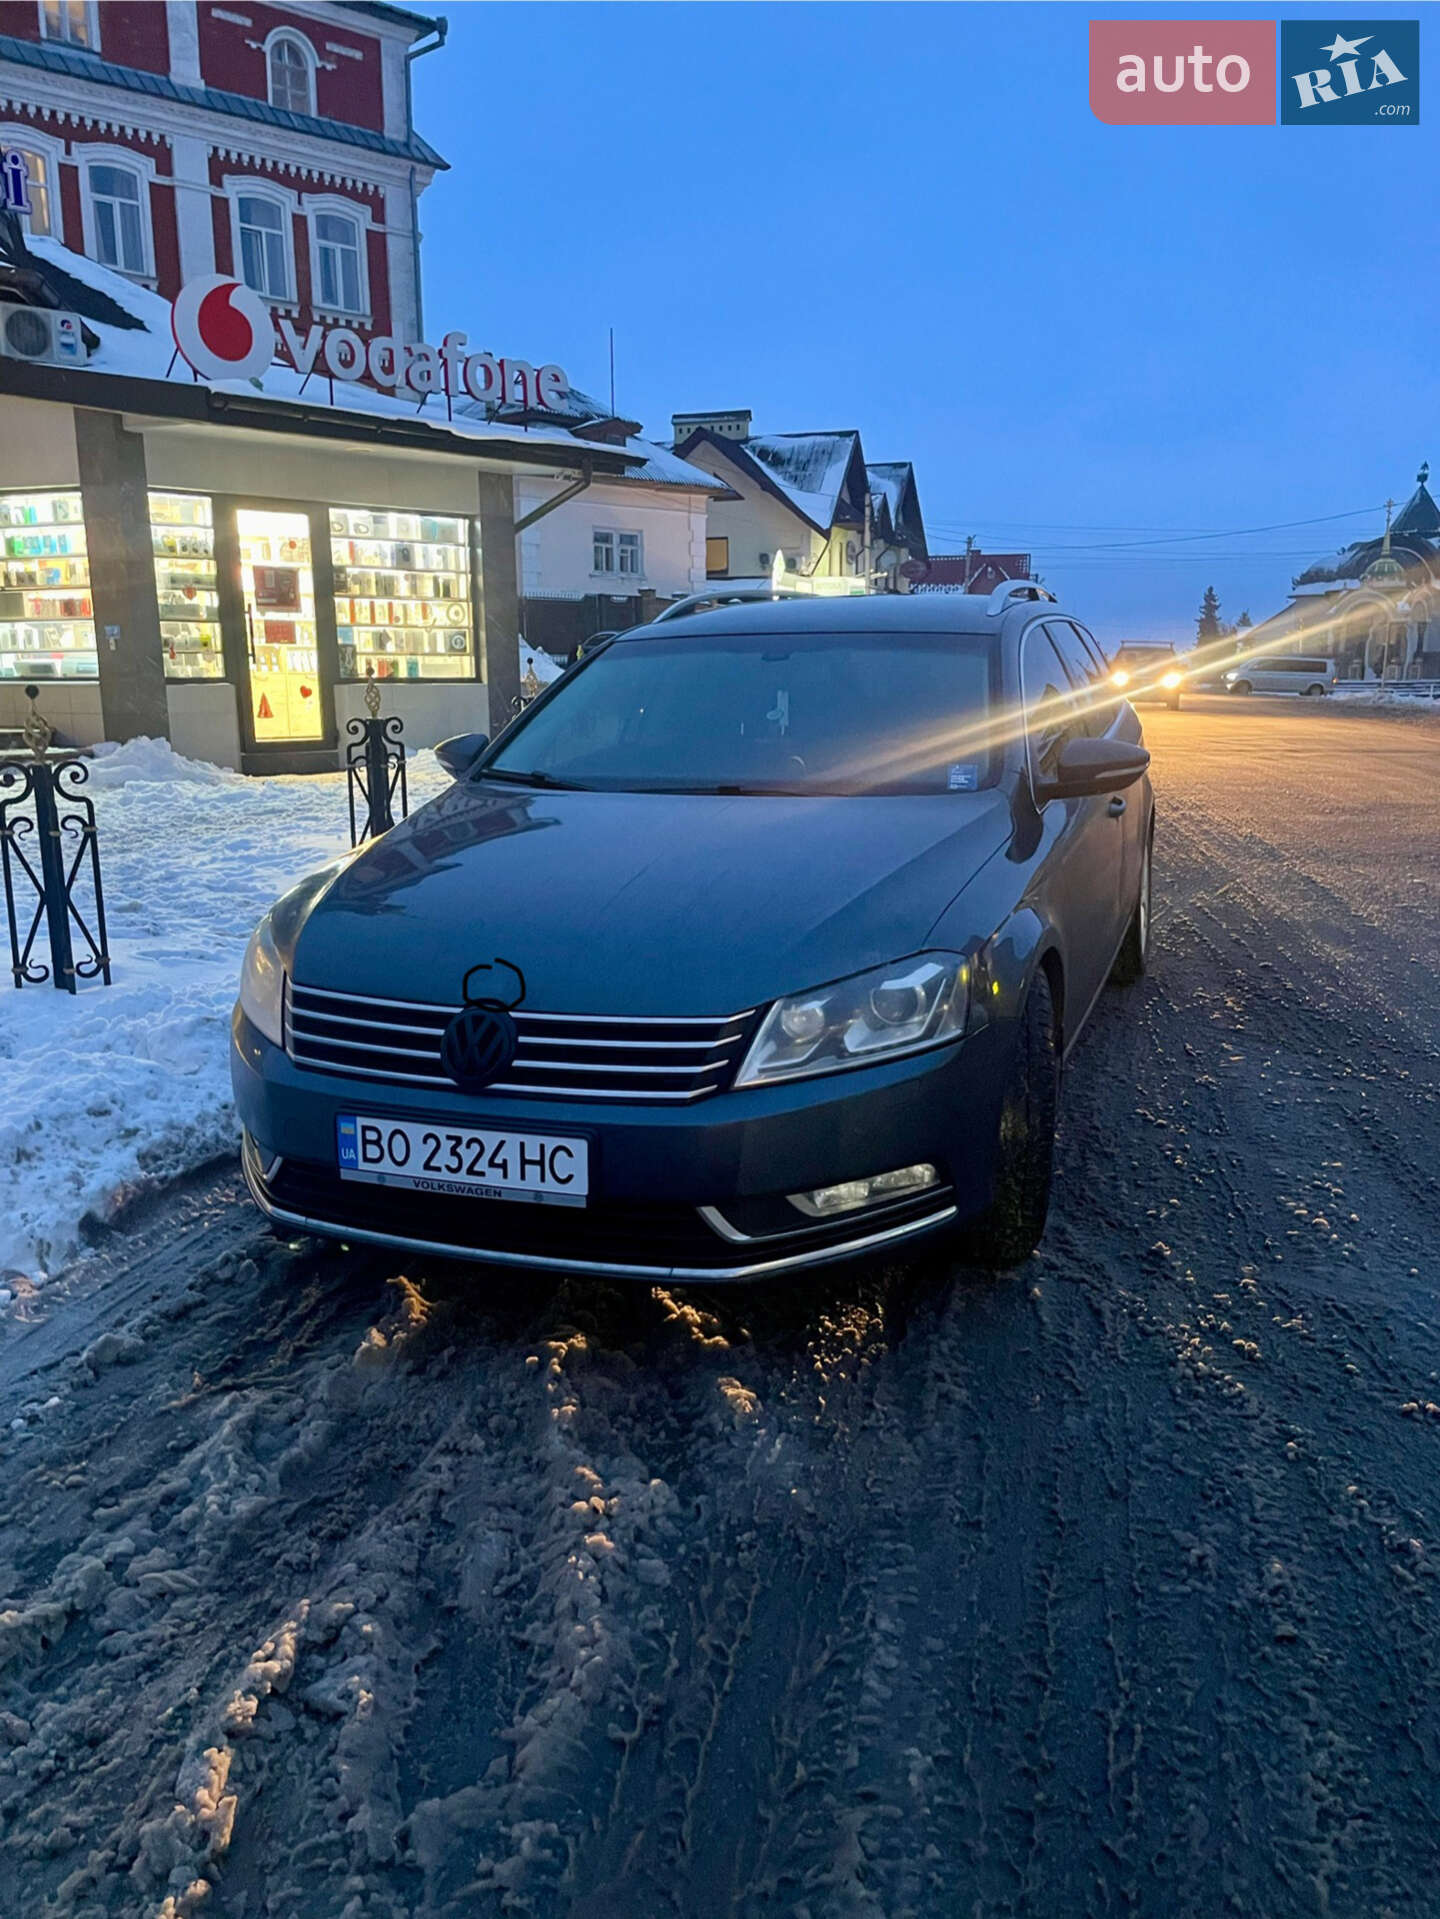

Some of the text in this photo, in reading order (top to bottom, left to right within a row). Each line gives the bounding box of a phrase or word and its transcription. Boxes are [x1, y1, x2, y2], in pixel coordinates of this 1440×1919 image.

[276, 318, 570, 411] vodafone
[341, 1147, 356, 1160] UA
[360, 1124, 575, 1185] BO 2324 HC
[412, 1178, 503, 1199] VOLKSWAGEN
